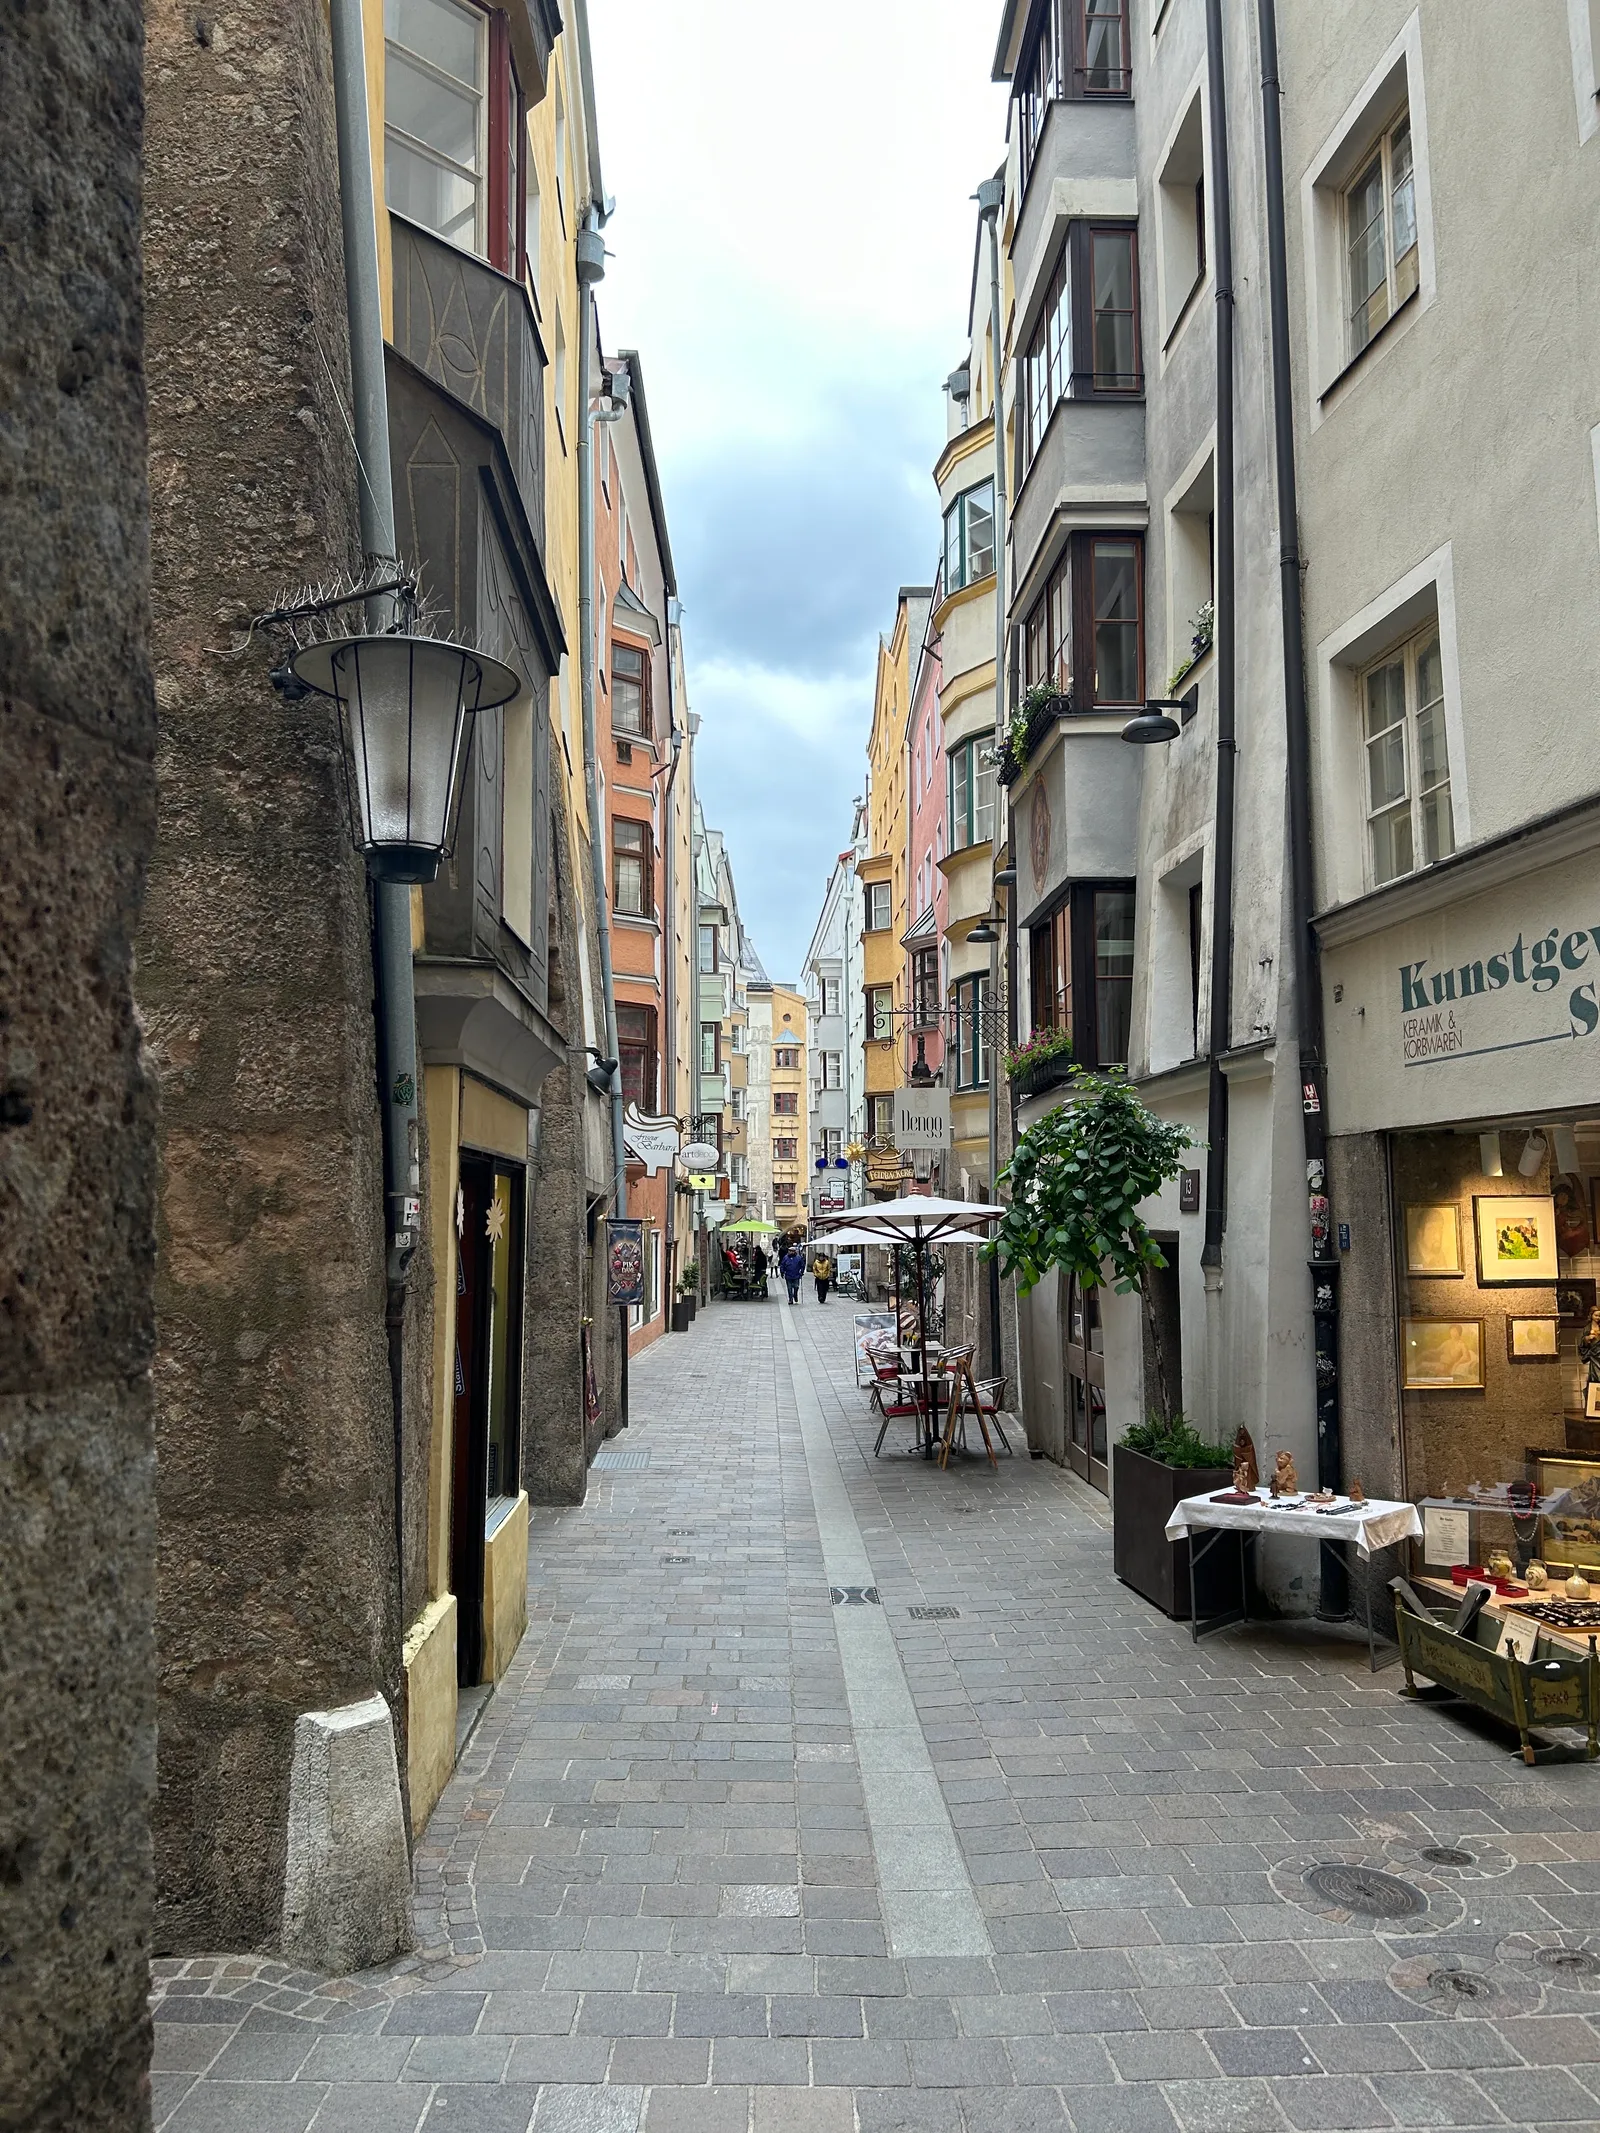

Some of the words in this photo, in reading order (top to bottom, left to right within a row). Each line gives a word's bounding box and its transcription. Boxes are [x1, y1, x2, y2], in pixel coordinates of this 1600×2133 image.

[1569, 980, 1600, 1040] S
[1403, 1012, 1444, 1039] KERAMIK
[1448, 1010, 1457, 1030] &
[1403, 1029, 1463, 1060] KORBWAREN
[901, 1109, 943, 1139] Dengg
[630, 1132, 660, 1143] Friseur
[636, 1140, 677, 1152] Barbara
[681, 1149, 716, 1159] artdepot
[1185, 1178, 1192, 1195] 13
[622, 1261, 634, 1269] PIK
